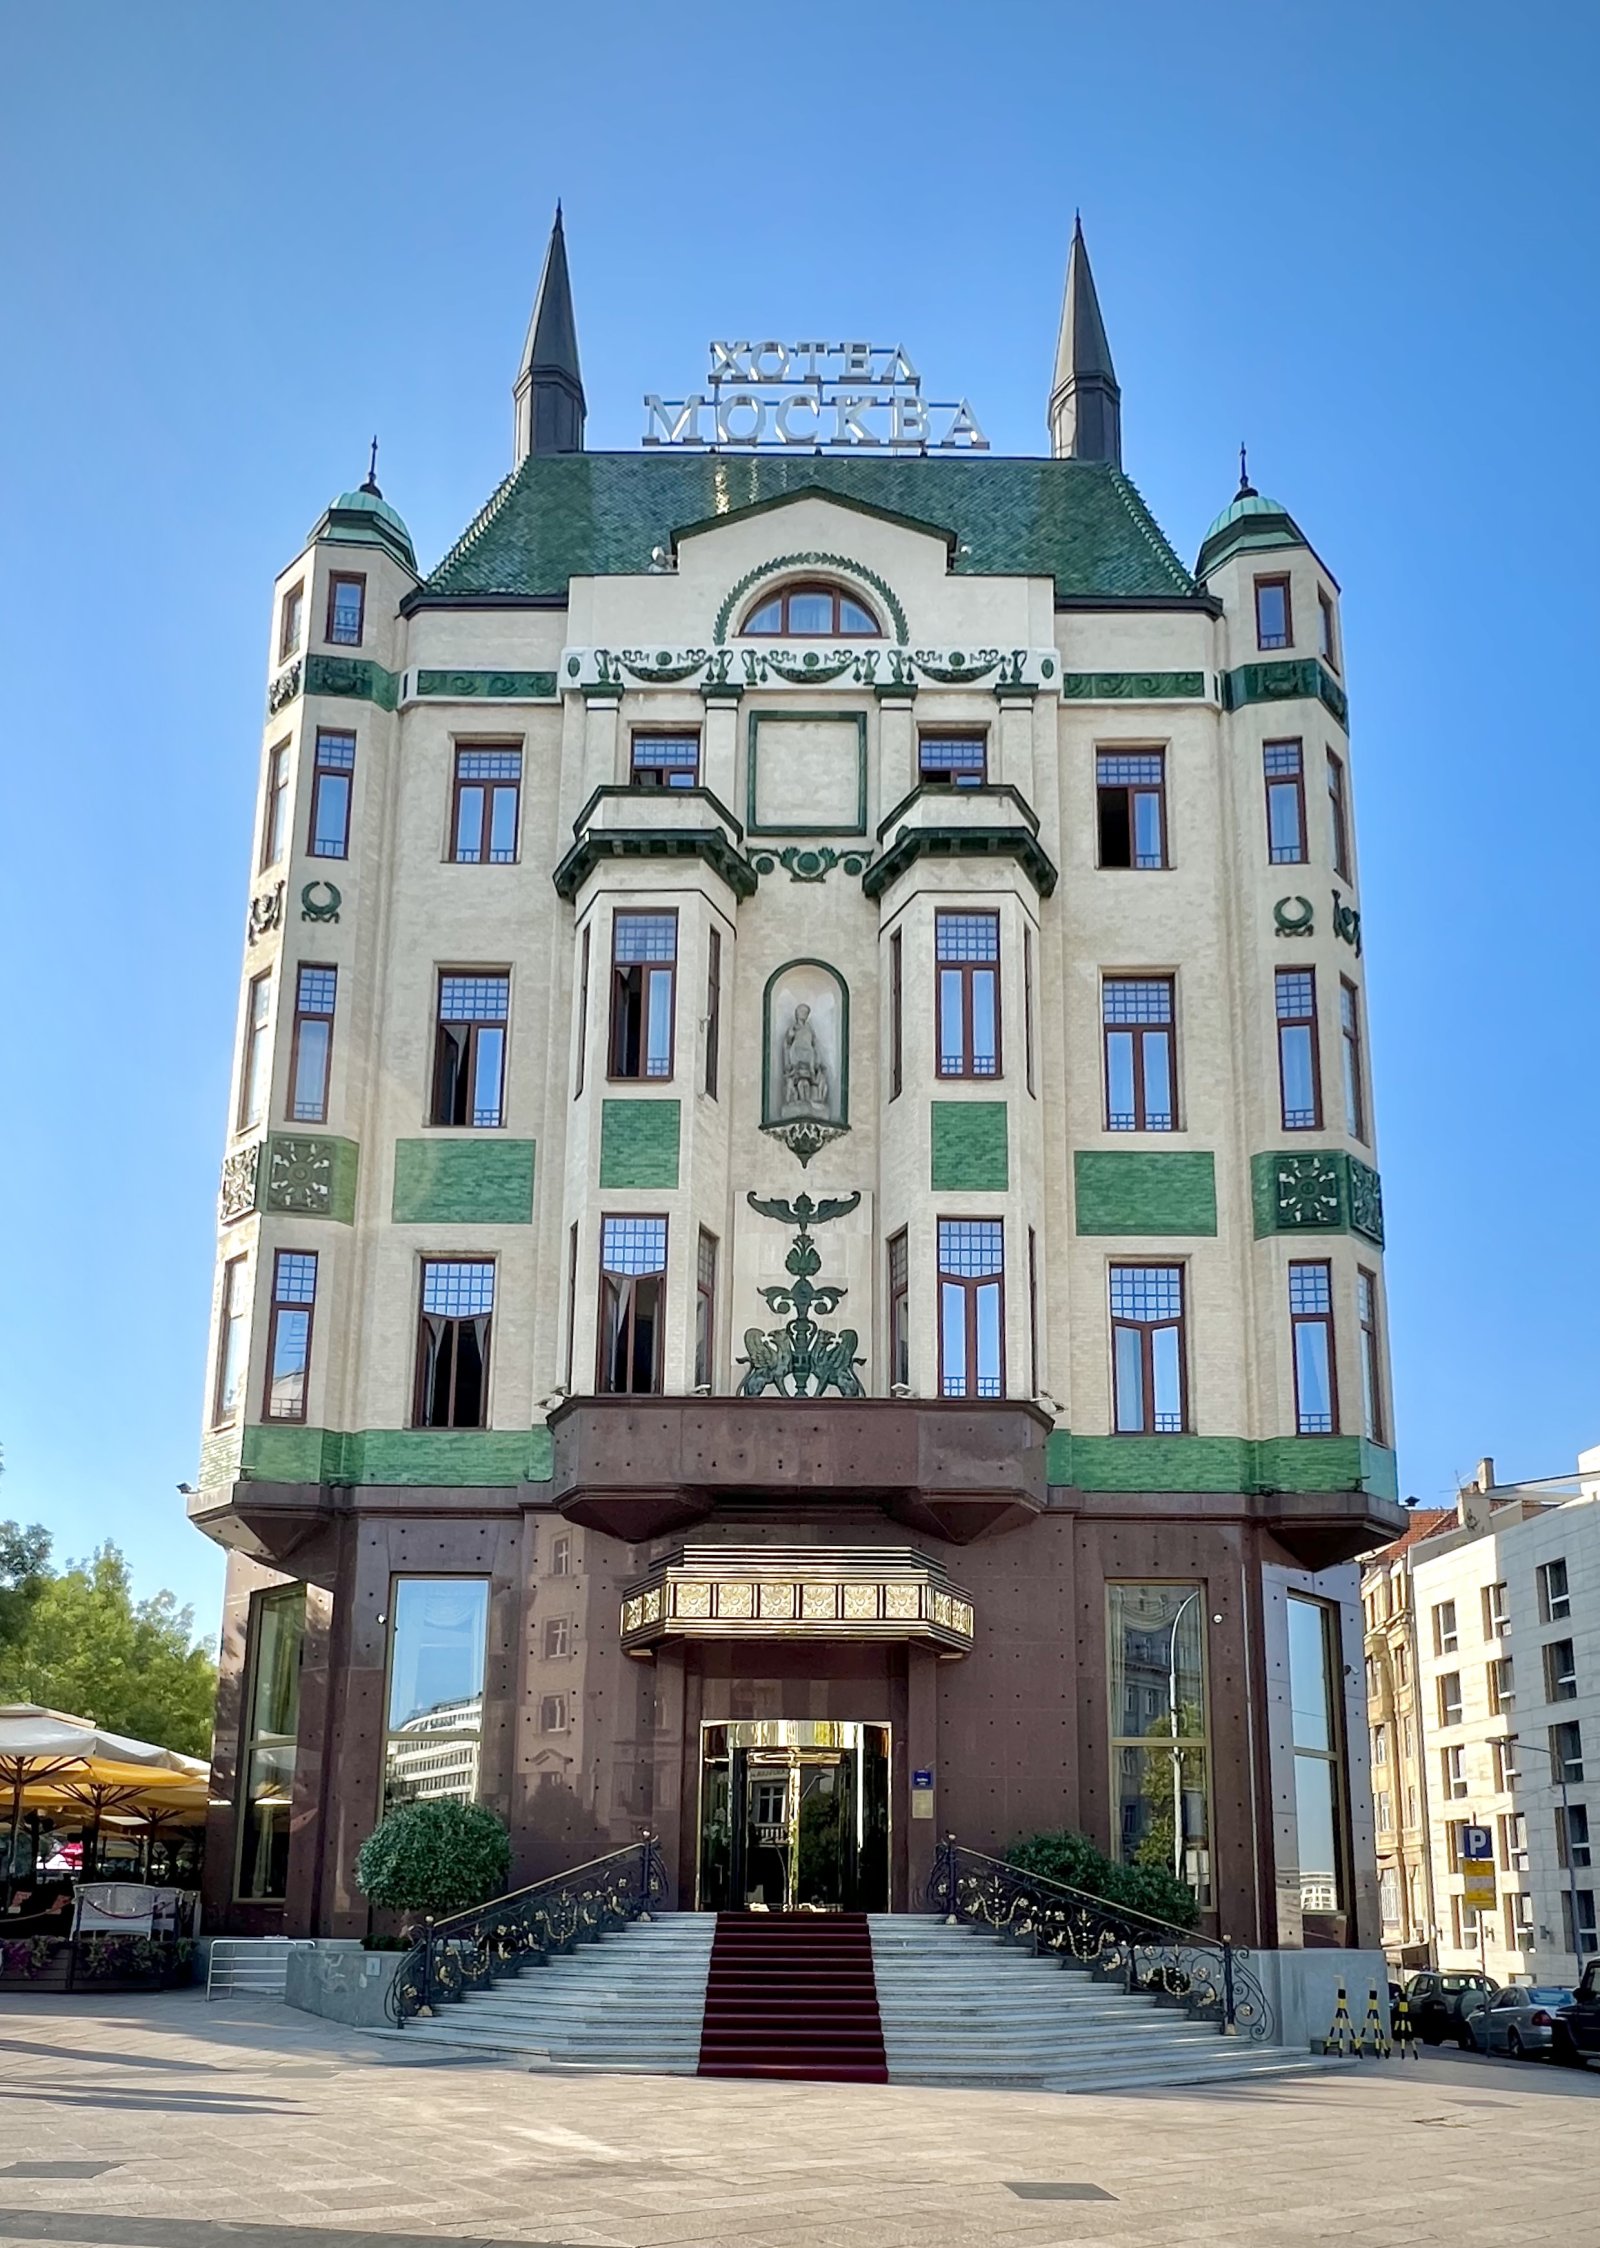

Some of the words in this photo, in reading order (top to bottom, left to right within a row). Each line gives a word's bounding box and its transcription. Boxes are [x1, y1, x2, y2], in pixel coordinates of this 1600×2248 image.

[708, 341, 921, 383] ХОТЕЛ
[642, 395, 990, 450] МОСКВА
[1469, 1829, 1486, 1855] P
